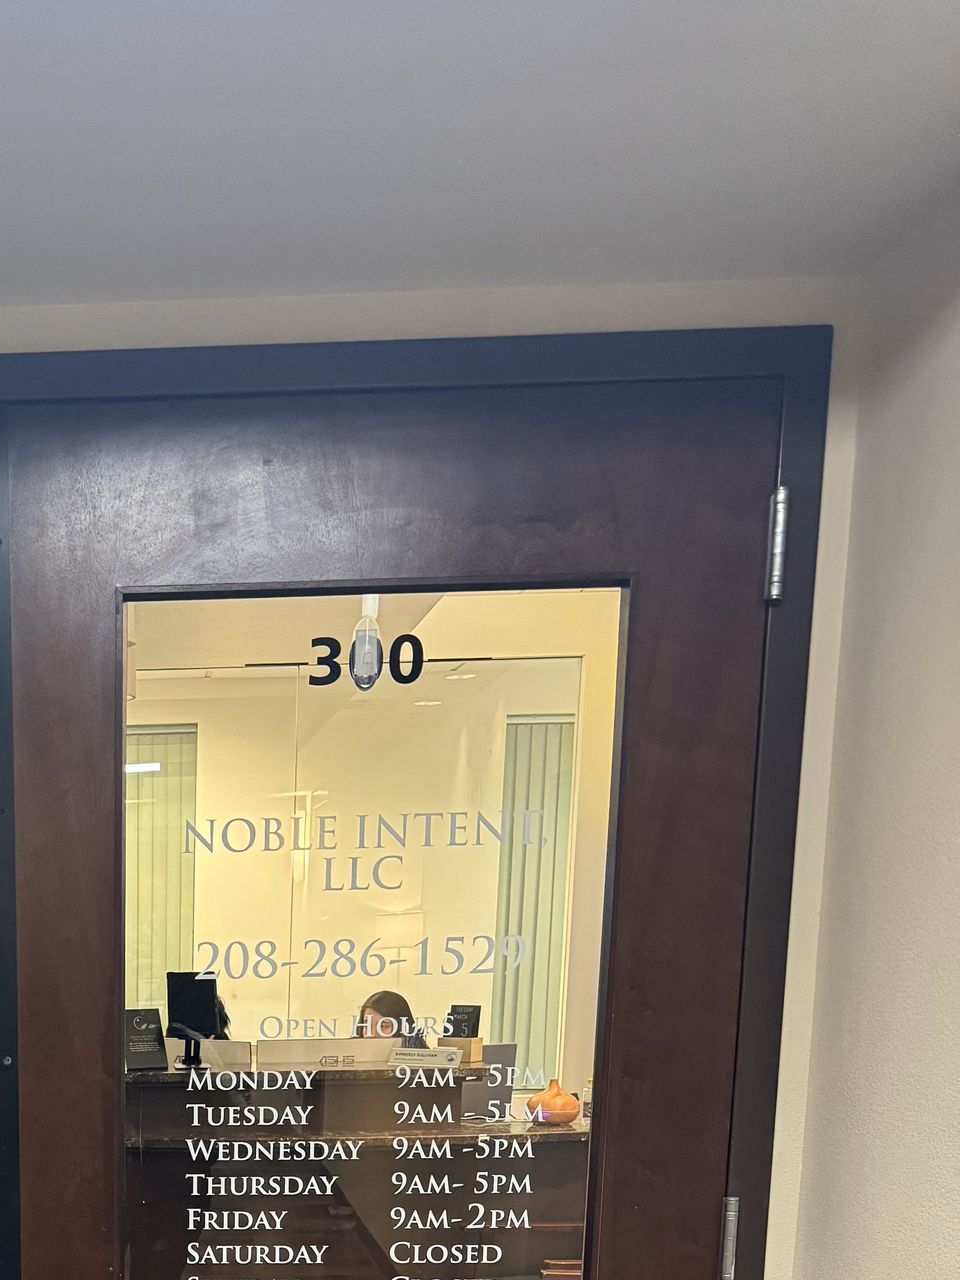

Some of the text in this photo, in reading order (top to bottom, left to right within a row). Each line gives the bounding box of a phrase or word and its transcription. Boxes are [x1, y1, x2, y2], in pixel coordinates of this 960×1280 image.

[308, 633, 424, 692] 300
[183, 815, 338, 854] NOBLE
[322, 855, 404, 891] LLC
[194, 934, 526, 980] 208-286-1529
